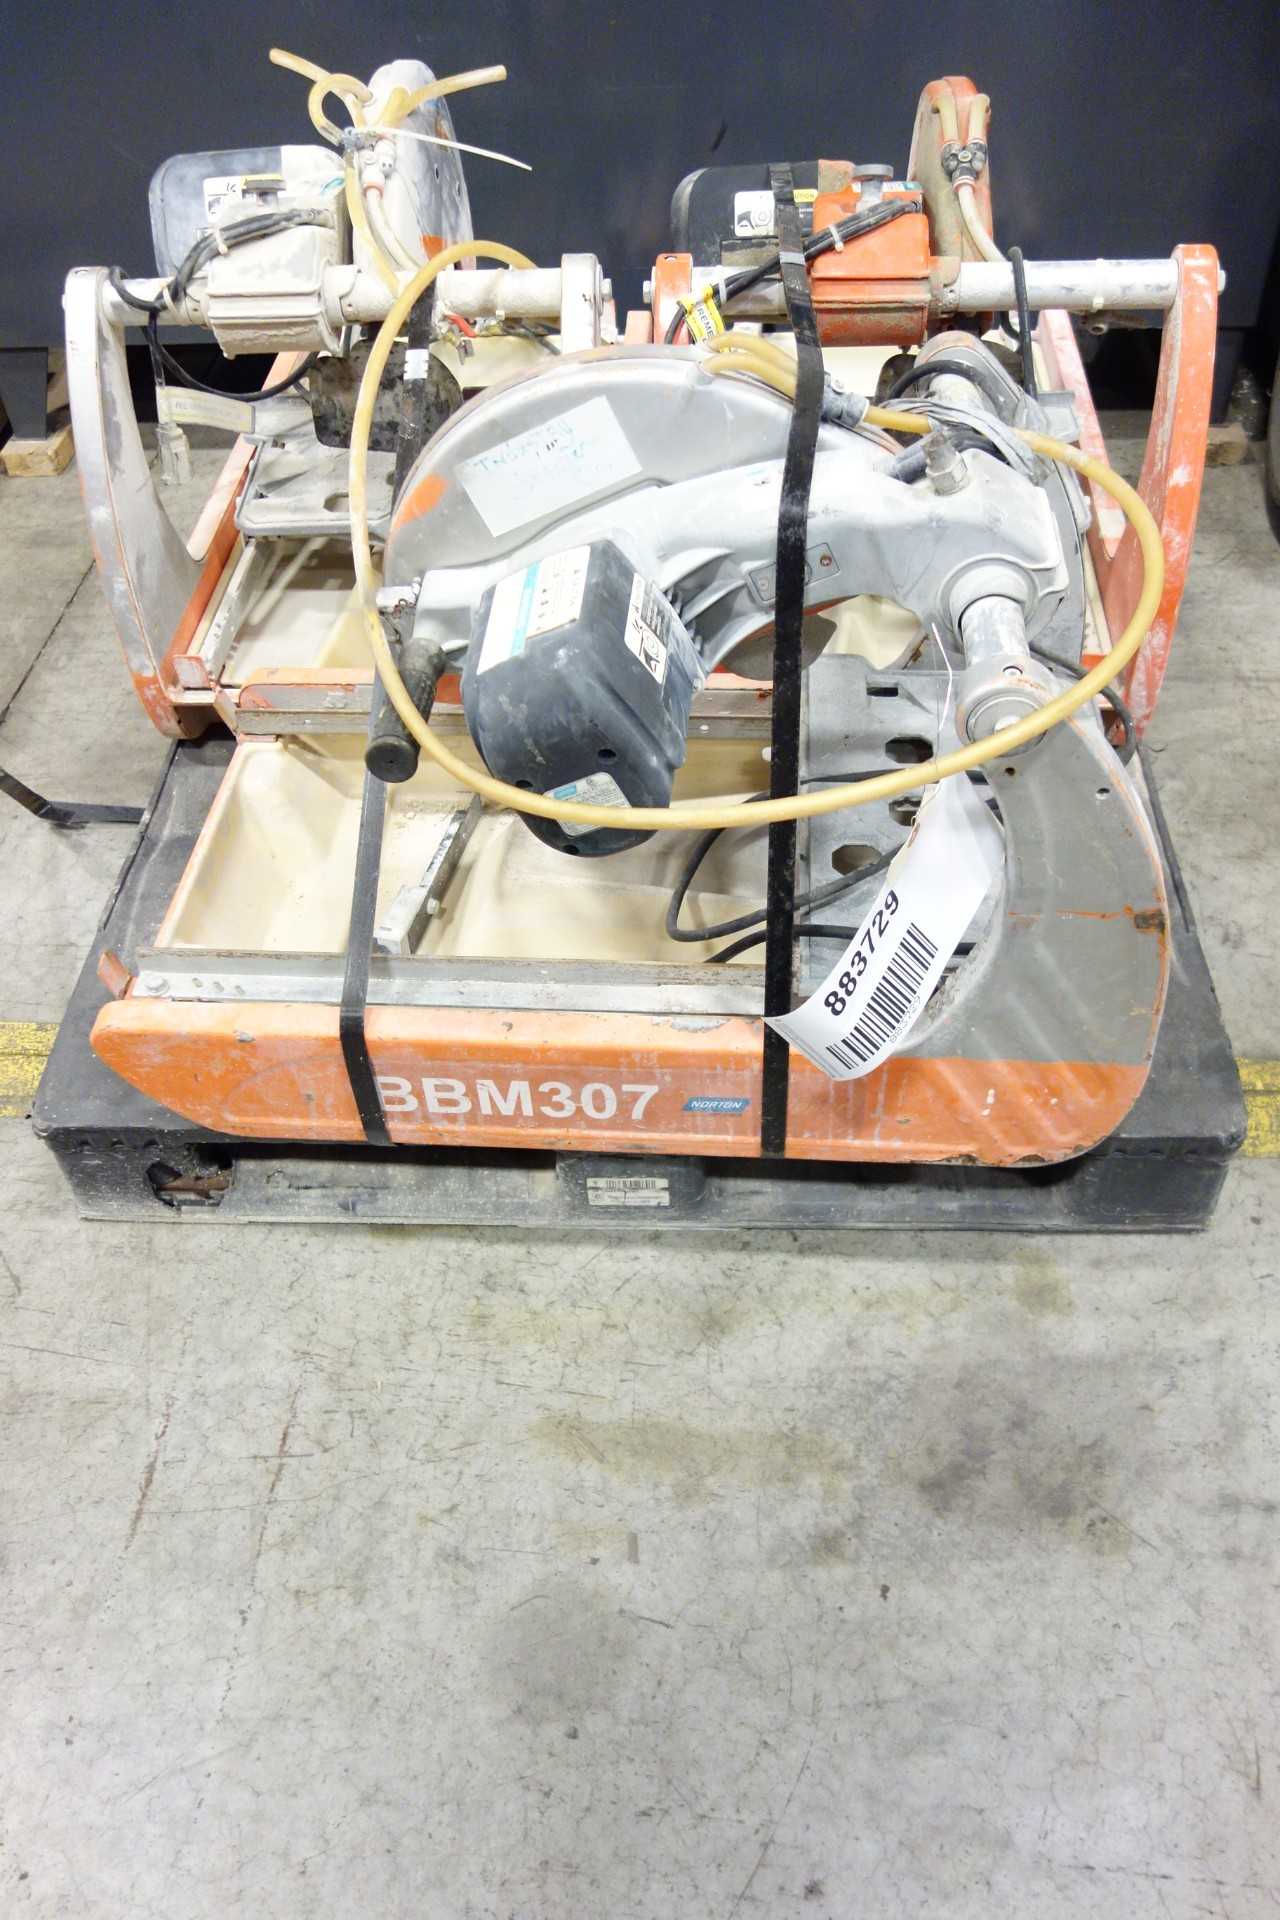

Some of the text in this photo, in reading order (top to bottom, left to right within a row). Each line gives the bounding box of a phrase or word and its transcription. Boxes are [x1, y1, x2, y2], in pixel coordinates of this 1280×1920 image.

[823, 889, 900, 1017] 883729
[376, 1075, 659, 1121] BBM307
[690, 1100, 744, 1110] NORTON
